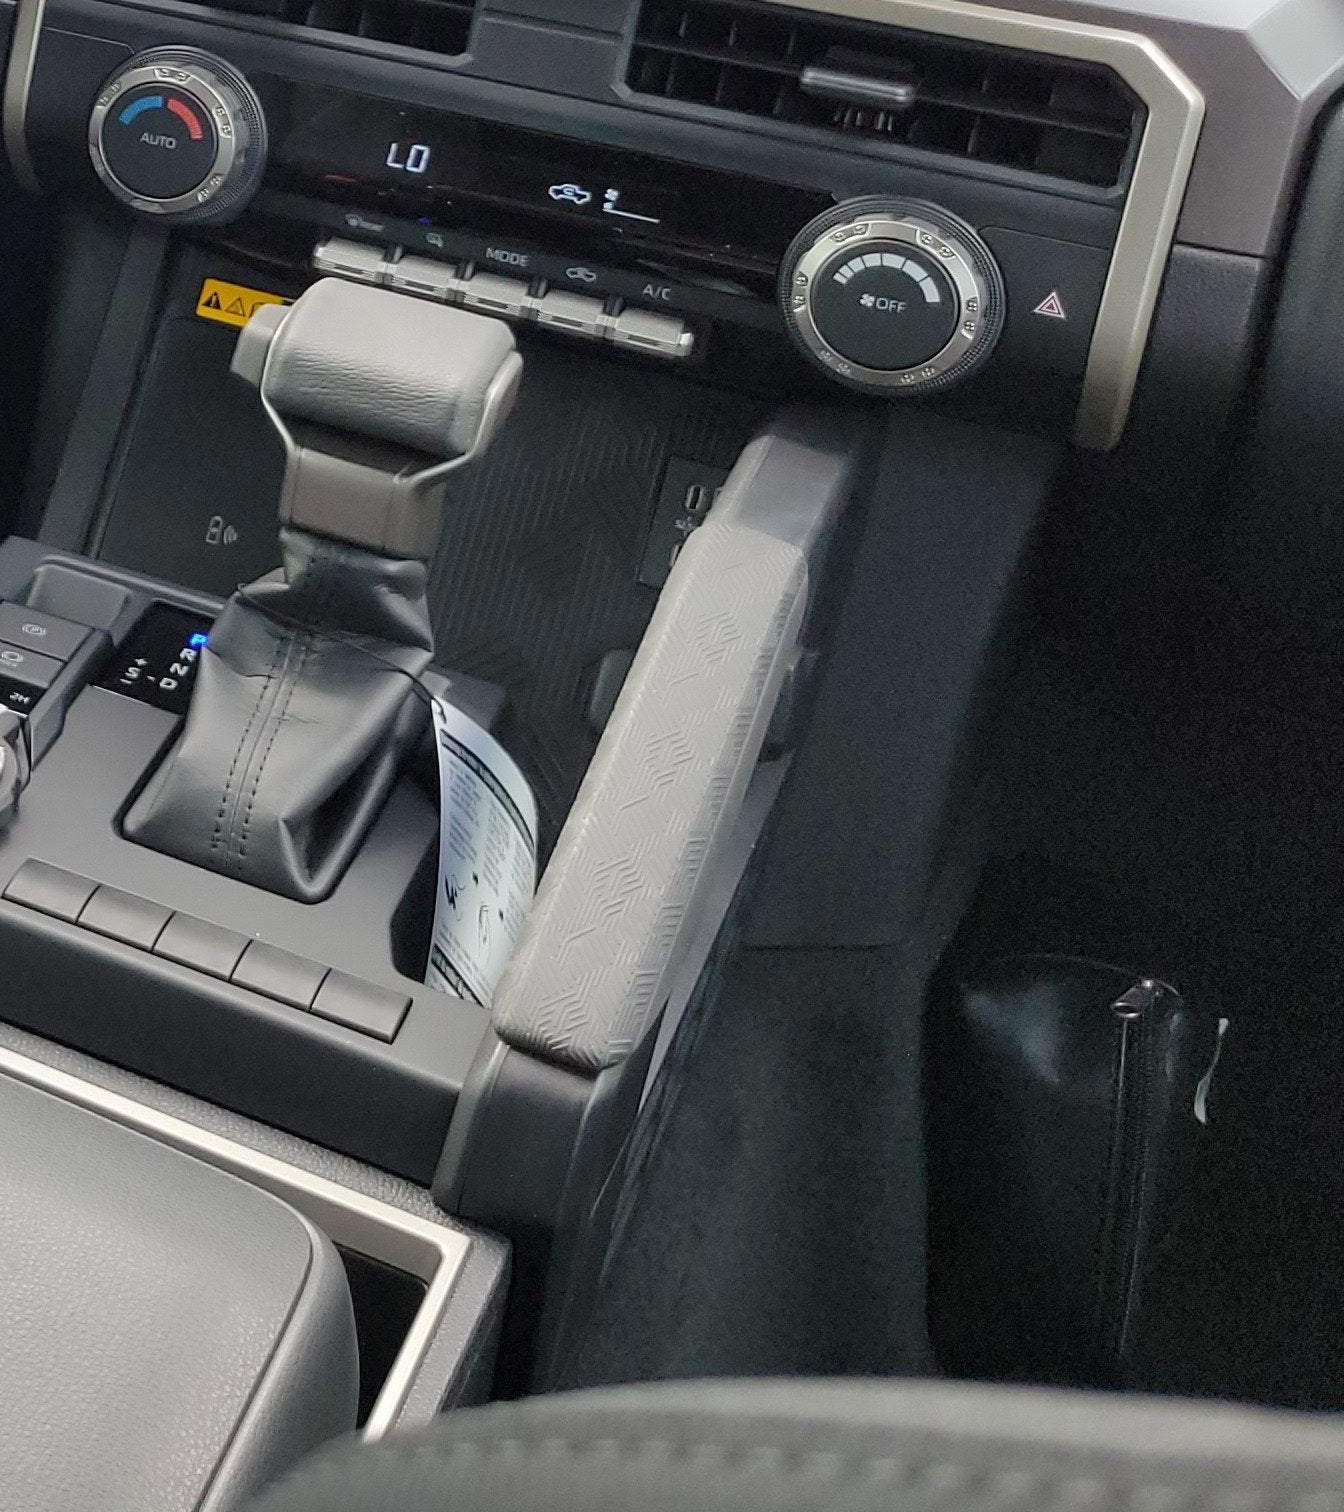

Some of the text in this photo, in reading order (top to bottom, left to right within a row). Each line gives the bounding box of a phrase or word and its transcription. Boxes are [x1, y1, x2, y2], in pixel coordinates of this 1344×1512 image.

[140, 132, 177, 150] AUTO
[386, 142, 431, 174] LO
[485, 247, 530, 267] MODE
[641, 283, 672, 301] A/C
[874, 296, 907, 314] OFF
[189, 632, 208, 646] P
[179, 648, 197, 663] R
[124, 667, 141, 679] S
[169, 662, 190, 677] N
[159, 677, 179, 690] D
